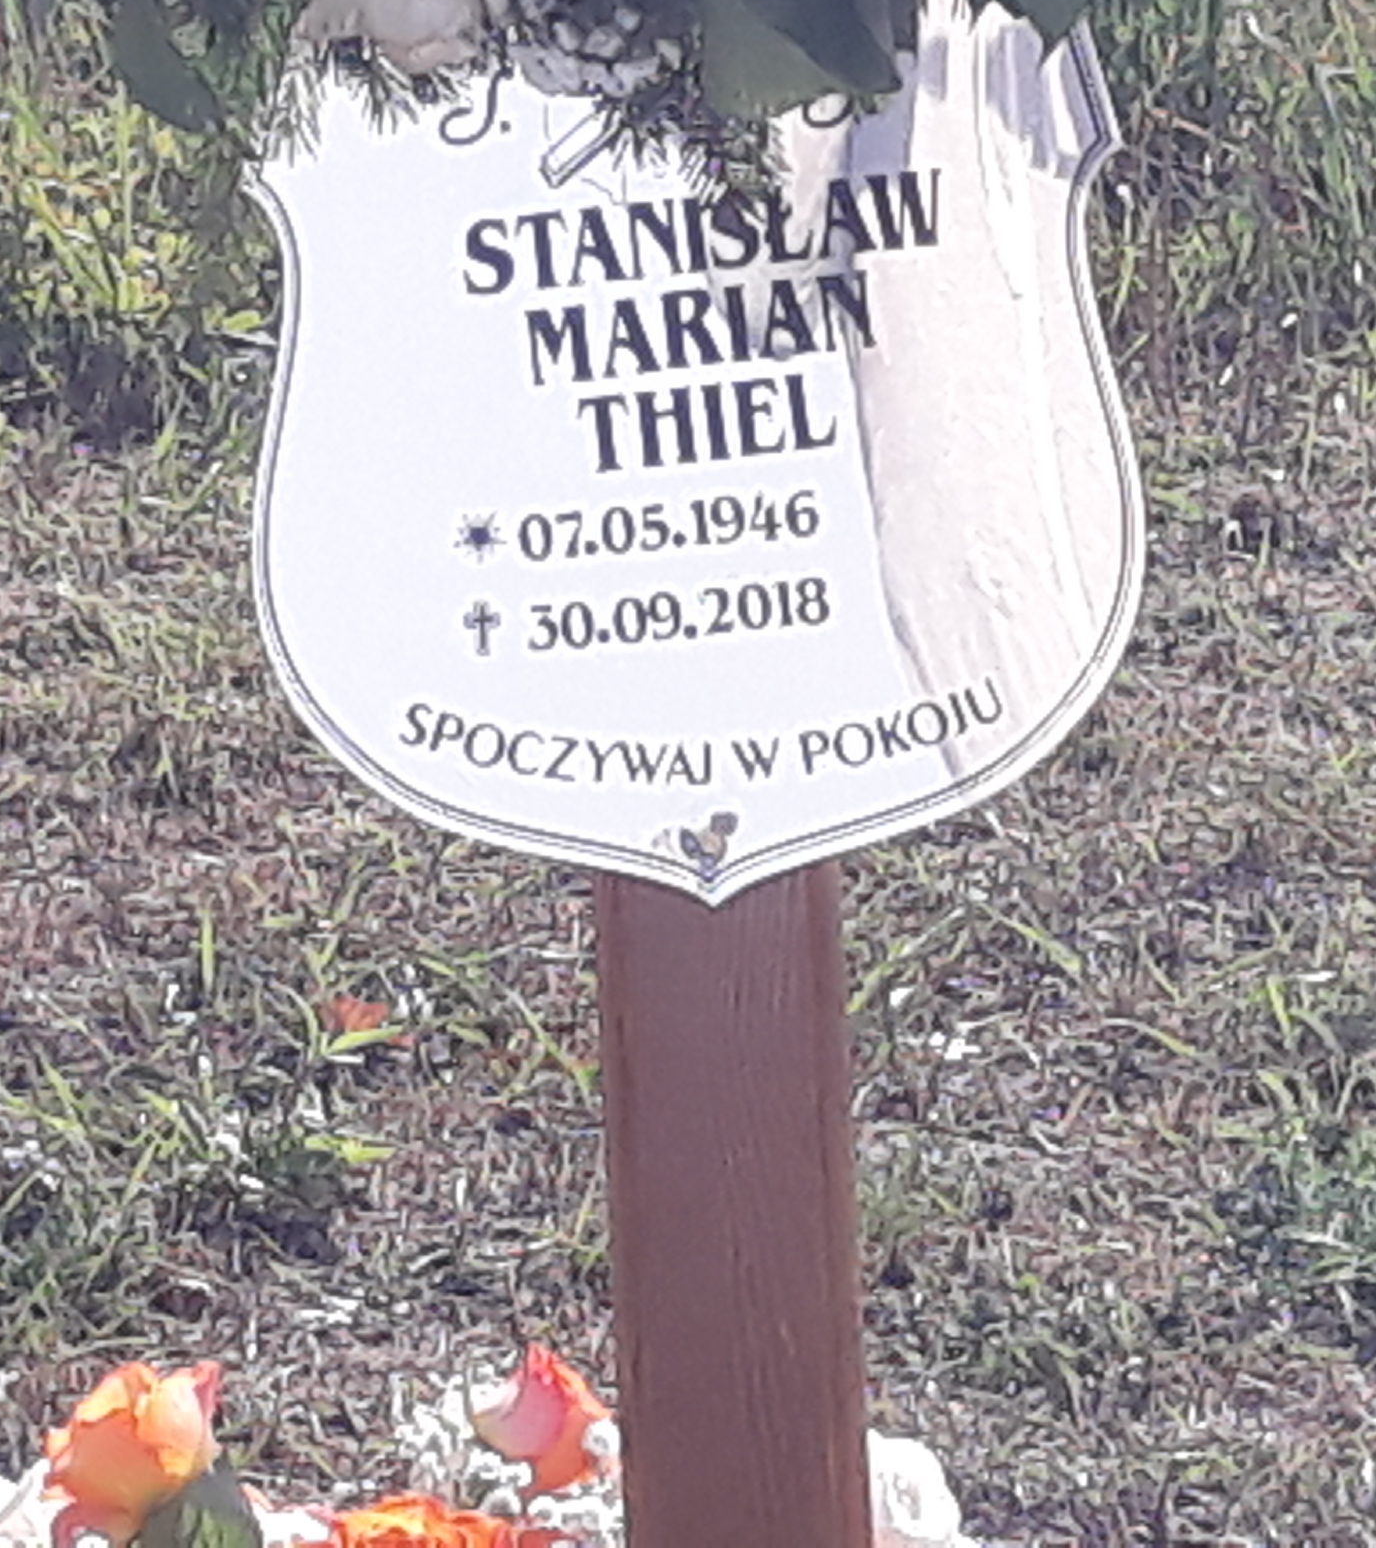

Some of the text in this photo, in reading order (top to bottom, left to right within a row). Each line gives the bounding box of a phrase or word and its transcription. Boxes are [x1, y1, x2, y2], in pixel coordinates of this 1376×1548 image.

[463, 168, 941, 295] STANISŁAW
[526, 272, 876, 386] MARIAN
[577, 373, 837, 474] THIEL
[517, 489, 821, 562] 07.05.1946
[527, 577, 830, 651] 30.09.2018
[398, 676, 1003, 786] SPOCZYWAJ W POKOJU
